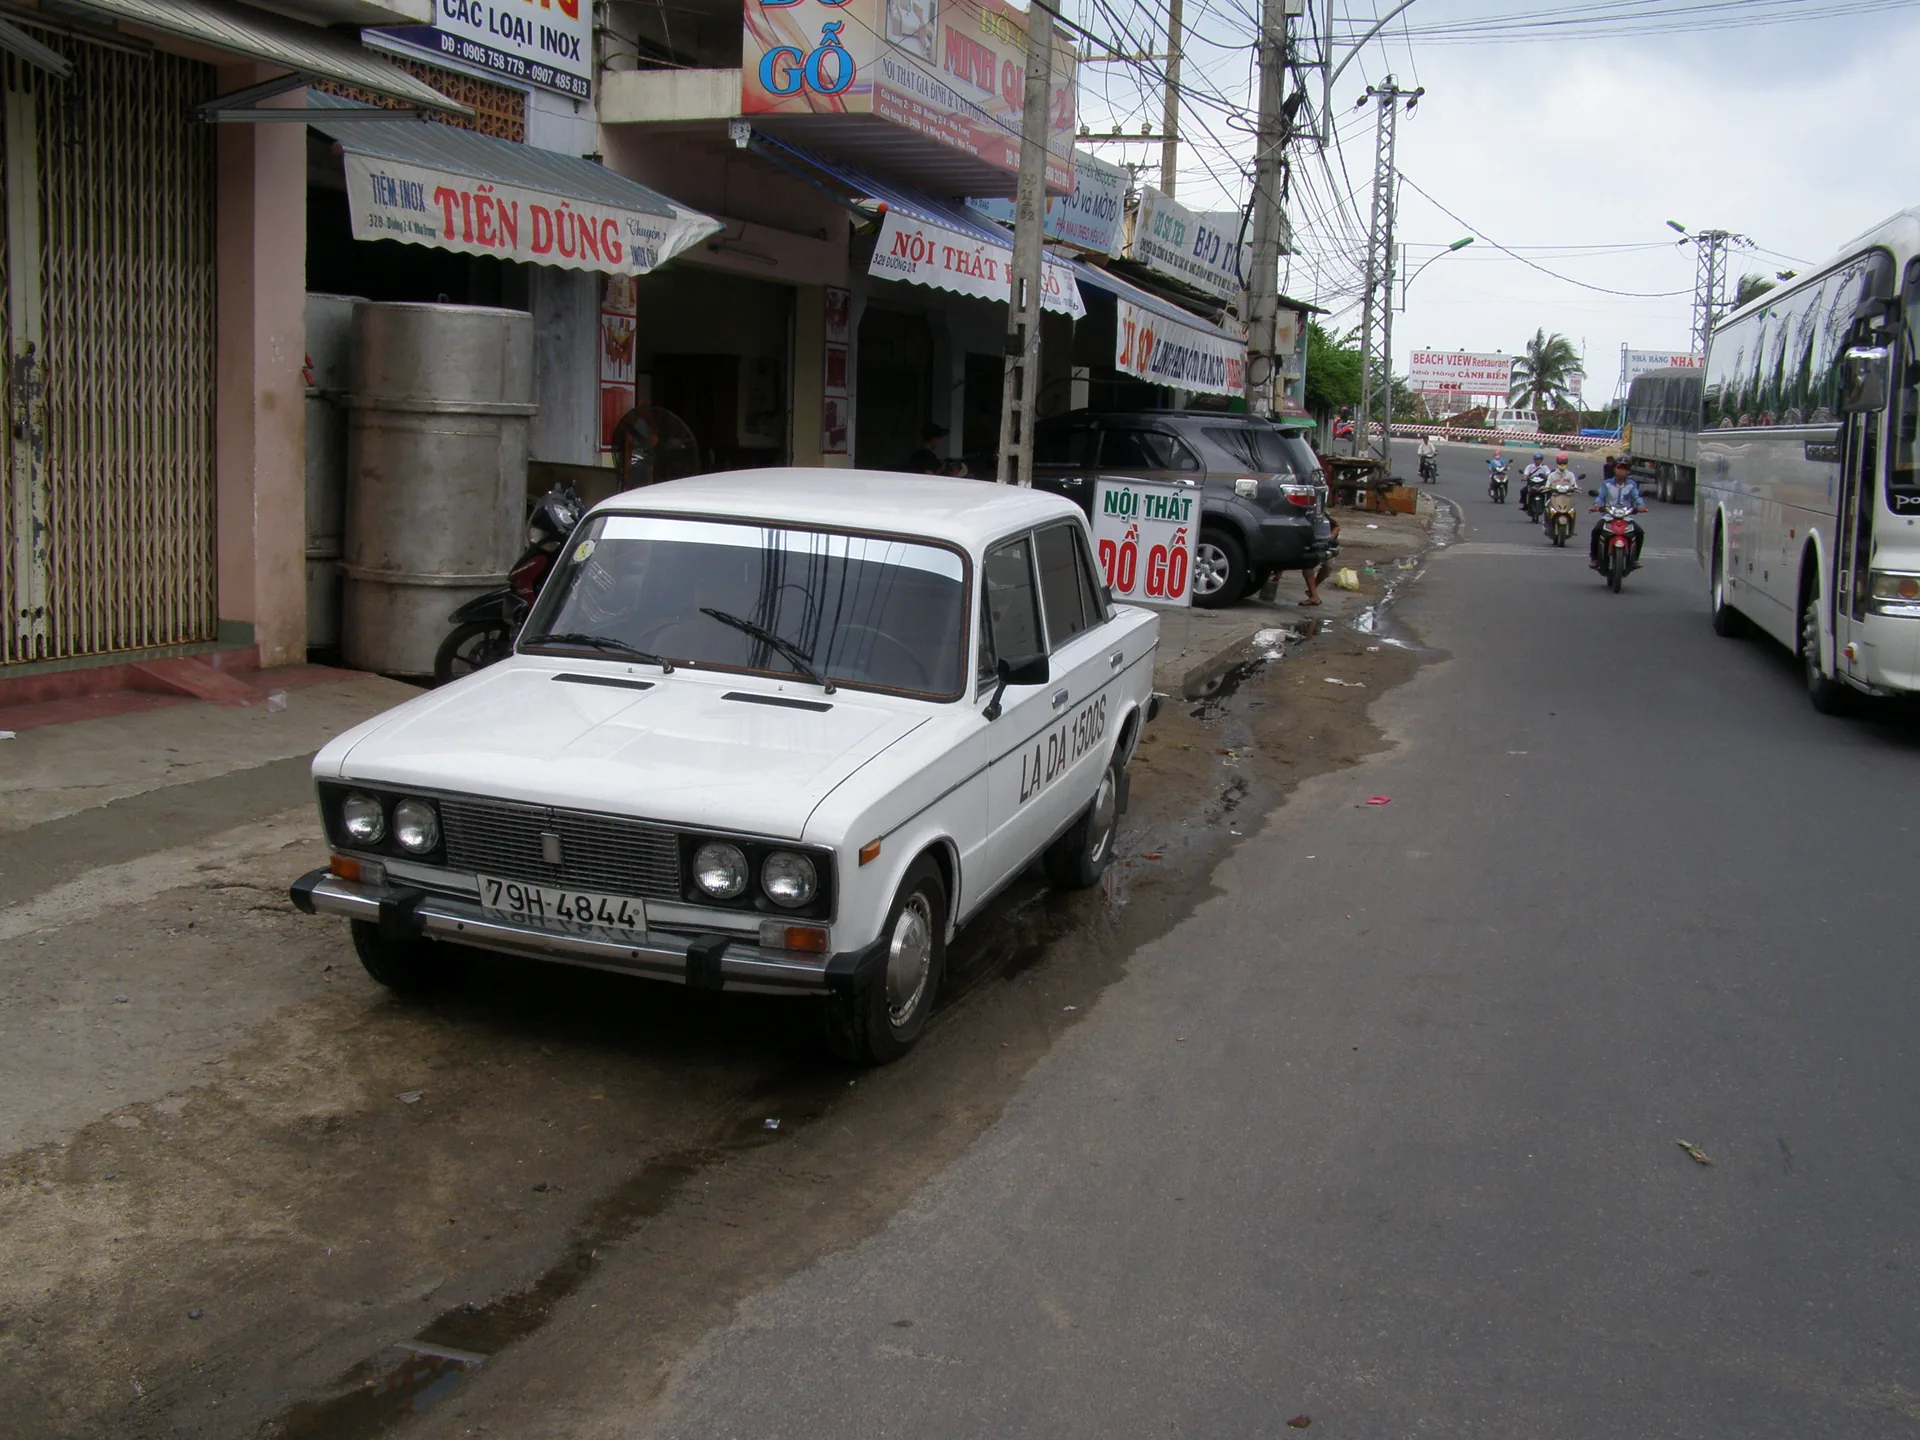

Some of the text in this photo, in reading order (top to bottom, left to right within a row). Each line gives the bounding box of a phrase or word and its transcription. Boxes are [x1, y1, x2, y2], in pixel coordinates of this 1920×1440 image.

[489, 7, 533, 48] LOẠI
[540, 24, 581, 62] INOX
[758, 19, 856, 97] GỖ
[944, 24, 997, 97] MINH
[463, 42, 486, 63] 0905
[488, 53, 505, 70] 758
[507, 57, 524, 76] 779
[532, 64, 553, 82] 0907
[555, 70, 571, 91] 485
[572, 75, 588, 95] 813
[917, 75, 929, 99] GIA
[368, 213, 383, 228] 328
[399, 180, 426, 213] INOX
[434, 184, 623, 264] TIẾN DŨNG
[1413, 353, 1509, 368] BEACH VIEW Restaurant
[1103, 487, 1192, 521] NỘI THẤT
[1145, 527, 1188, 599] GỖ
[1071, 693, 1107, 761] 1500S
